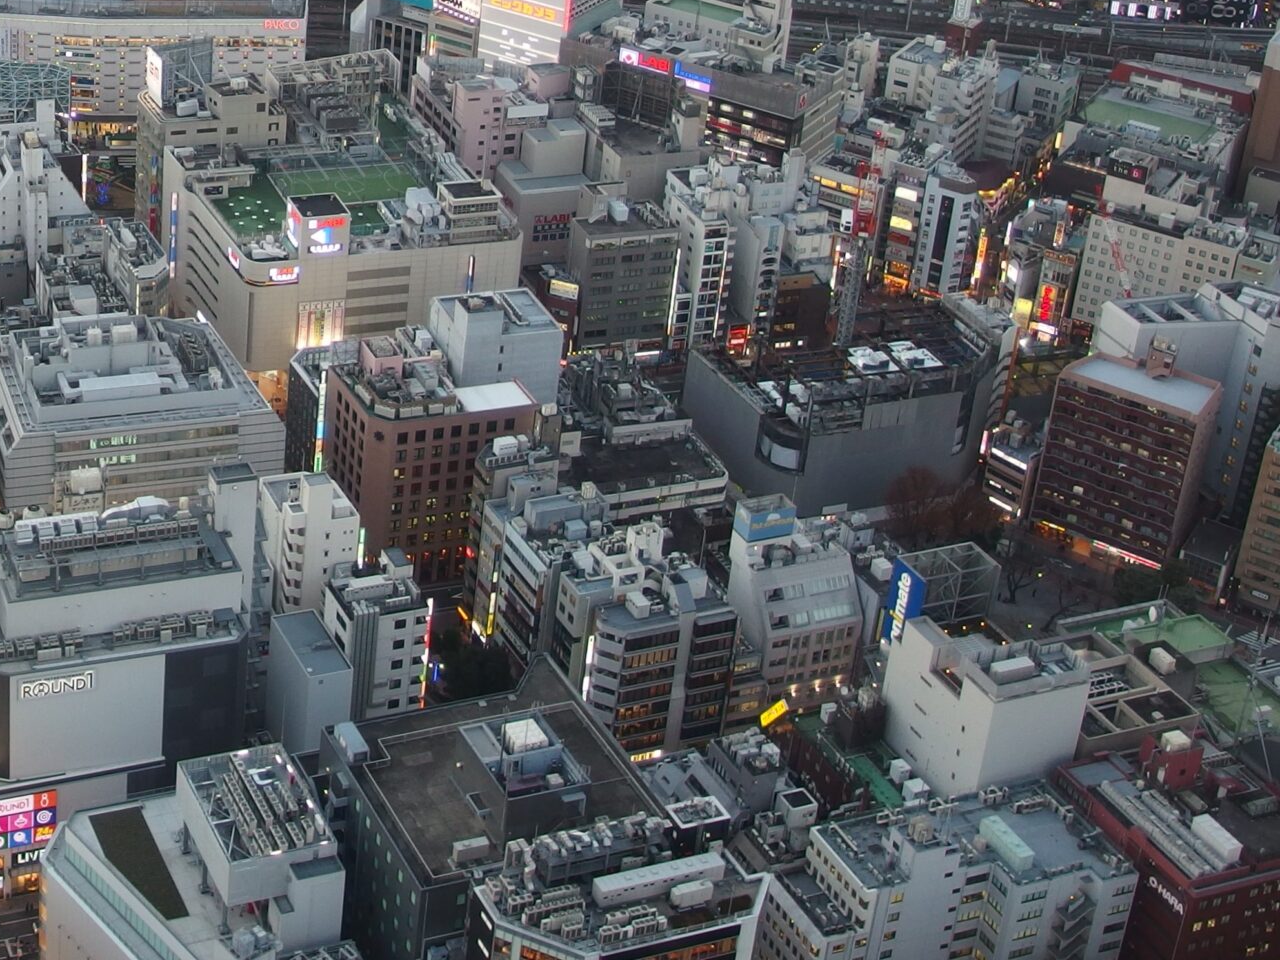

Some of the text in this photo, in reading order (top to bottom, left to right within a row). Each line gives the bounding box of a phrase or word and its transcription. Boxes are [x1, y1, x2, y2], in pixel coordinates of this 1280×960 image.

[264, 19, 299, 31] PARCO
[639, 53, 669, 73] LABI
[544, 214, 570, 224] LABI
[22, 672, 93, 698] ROUND1
